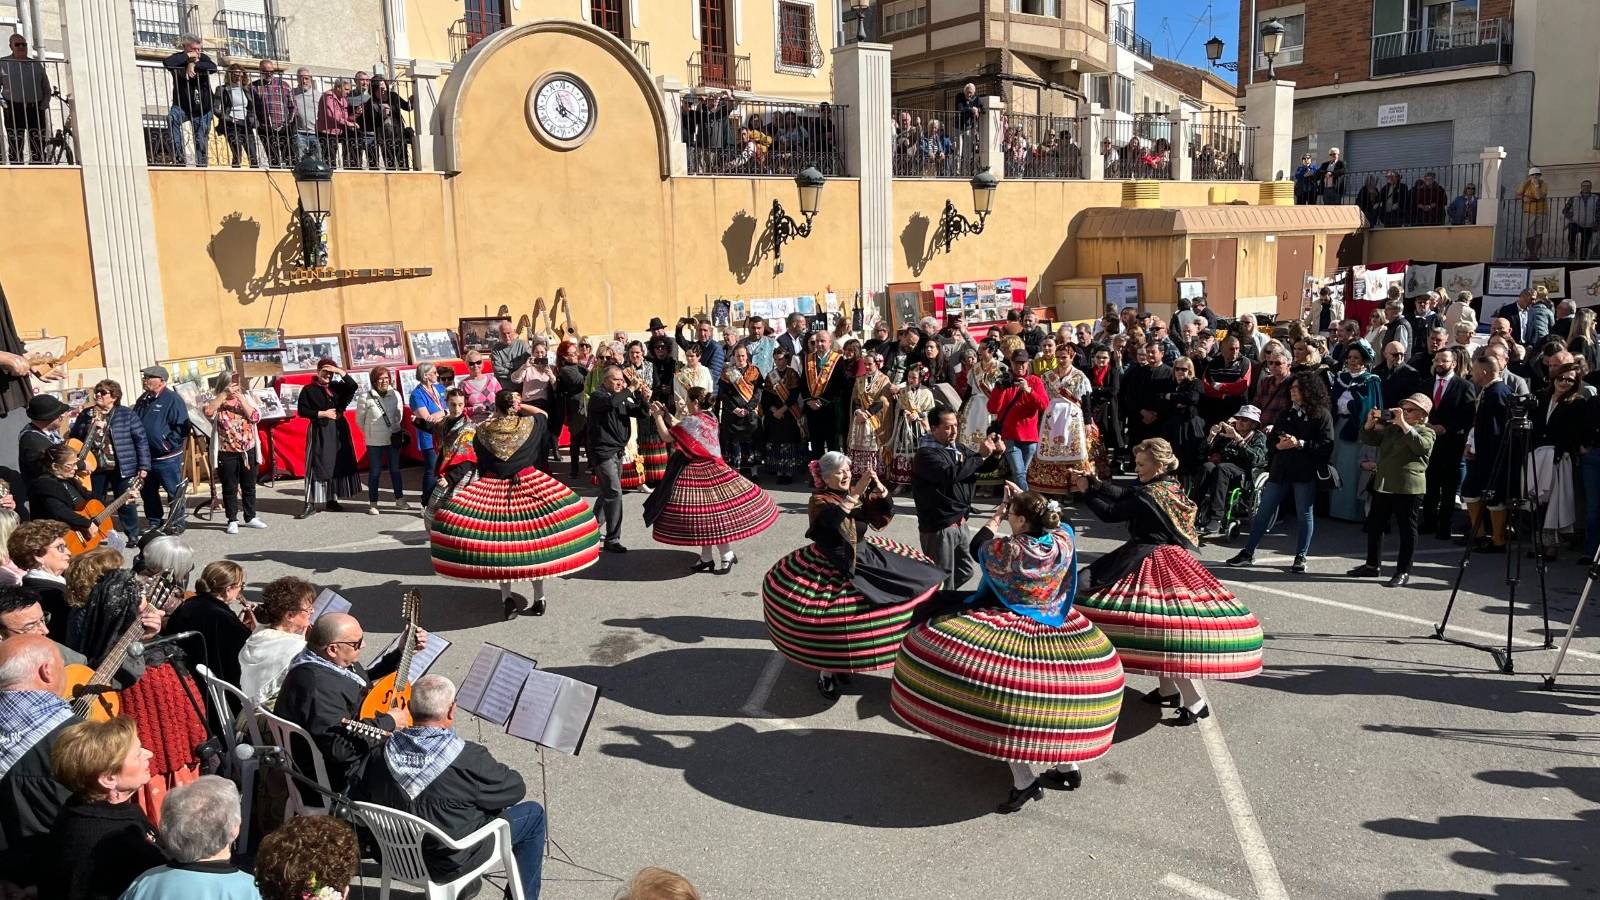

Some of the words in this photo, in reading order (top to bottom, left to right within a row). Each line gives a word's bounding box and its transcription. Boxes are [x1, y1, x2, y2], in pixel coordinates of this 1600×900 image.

[289, 270, 336, 279] MONTE
[345, 269, 359, 278] DE
[370, 268, 385, 277] LA
[393, 267, 419, 277] SAL
